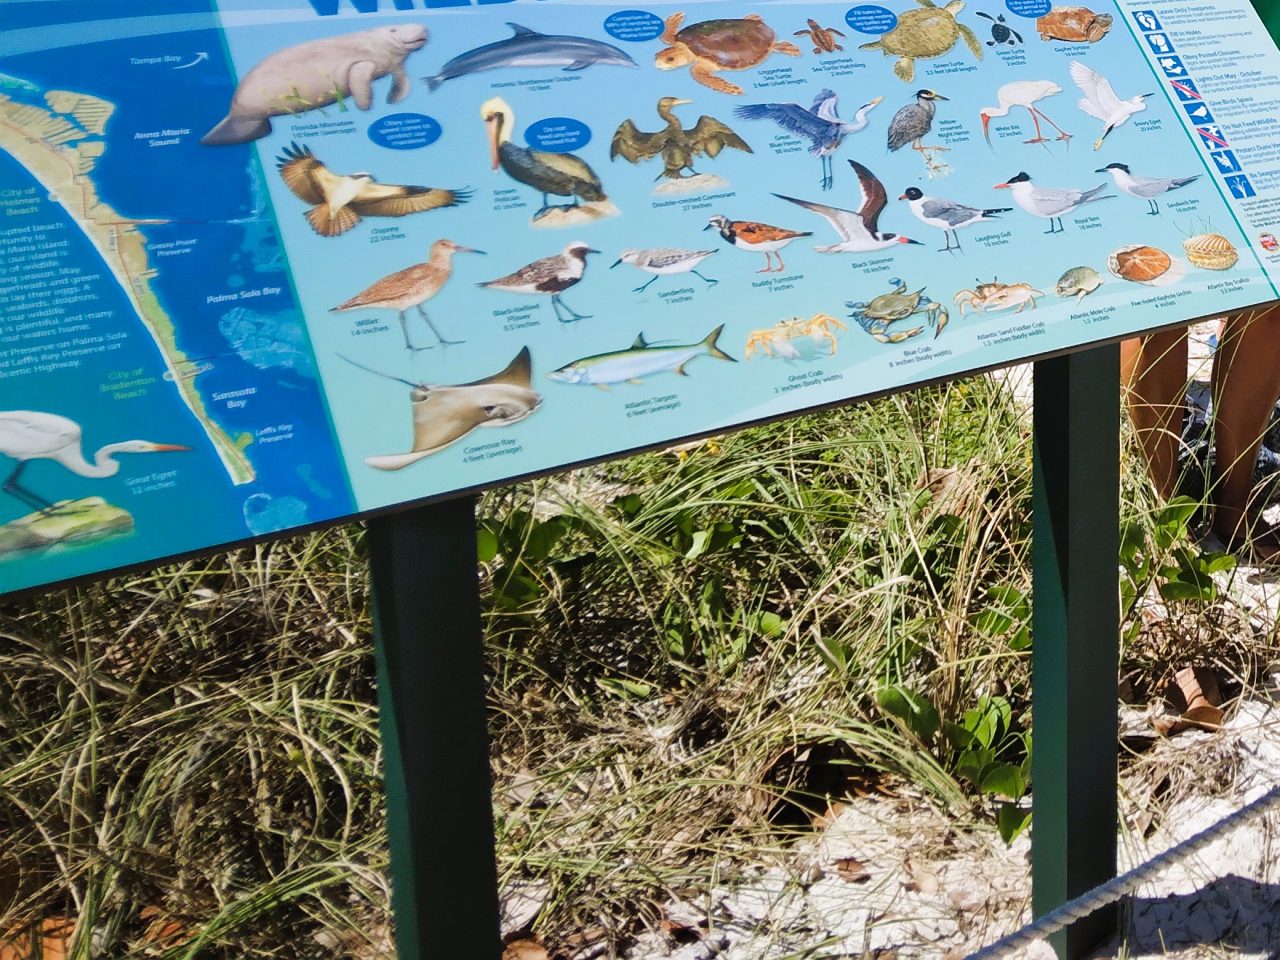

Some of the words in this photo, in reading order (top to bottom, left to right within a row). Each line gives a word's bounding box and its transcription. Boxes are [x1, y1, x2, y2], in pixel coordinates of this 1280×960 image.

[1188, 5, 1216, 13] Footprints
[130, 56, 163, 65] Tampa
[164, 55, 181, 63] Bay
[819, 57, 853, 66] Loggerhead
[1182, 53, 1198, 61] Obey
[839, 62, 866, 71] Hatchling
[950, 60, 964, 68] Turtle
[757, 67, 793, 76] Loggerhead
[944, 66, 958, 74] (shell
[1133, 120, 1148, 128] Snowy
[1257, 118, 1277, 126] Wildlife
[134, 131, 160, 140] Anna
[161, 128, 191, 136] Maria
[938, 131, 953, 139] Night
[149, 138, 180, 147] Sound
[786, 139, 801, 147] Heron
[1236, 146, 1256, 154] Protect
[691, 202, 713, 210] inches
[1166, 200, 1189, 209] Sandwich
[1074, 217, 1088, 225] Royal
[380, 231, 406, 241] inches
[974, 234, 1000, 244] Laughing
[1001, 230, 1012, 238] Gull
[990, 238, 1009, 246] inches
[852, 261, 868, 270] Black
[868, 256, 894, 266] Skimmer
[870, 265, 890, 273] inches
[752, 280, 773, 289] Ruddy
[773, 273, 804, 284] Turnstone
[1207, 282, 1223, 290] Atlantic
[1224, 280, 1232, 289] Bay
[1233, 277, 1250, 287] Scallop
[774, 283, 794, 292] inches
[1228, 285, 1244, 294] inches
[206, 294, 238, 304] Palma
[239, 290, 261, 299] Sola
[262, 287, 281, 296] Bay
[671, 295, 693, 304] inches
[1156, 293, 1176, 303] Keyhole
[1176, 289, 1192, 298] Urchin
[1160, 299, 1176, 308] inches
[1070, 310, 1089, 320] Atlantic
[1089, 308, 1103, 317] Mole
[1103, 305, 1116, 314] Crab
[354, 317, 379, 328] Willet
[1092, 314, 1110, 323] inches
[362, 325, 390, 335] inches
[976, 330, 998, 341] Atlantic
[999, 326, 1012, 336] Sand
[1013, 323, 1031, 334] Fiddler
[1031, 321, 1045, 329] Crab
[72, 335, 104, 345] Palma
[105, 331, 128, 340] Sola
[992, 336, 1010, 345] inches
[1010, 332, 1027, 343] (body
[1027, 328, 1046, 338] width)
[40, 353, 60, 362] Key
[62, 345, 105, 357] Preserve
[903, 349, 917, 357] Blue
[917, 345, 932, 354] Crab
[895, 357, 915, 367] inches
[915, 353, 933, 364] (body
[933, 349, 953, 360] width)
[108, 370, 129, 380] City
[132, 367, 144, 376] of
[788, 372, 808, 383] Ghost
[808, 369, 824, 378] Crab
[781, 382, 802, 392] inches
[803, 377, 822, 388] (body
[822, 373, 843, 384] width)
[113, 388, 147, 400] Beach
[212, 387, 257, 401] Sarasota
[227, 399, 247, 409] Bay
[278, 423, 293, 433] Key
[259, 431, 294, 444] Preserve
[463, 441, 499, 455] Cownose
[501, 438, 516, 448] Ray
[469, 453, 486, 462] feet
